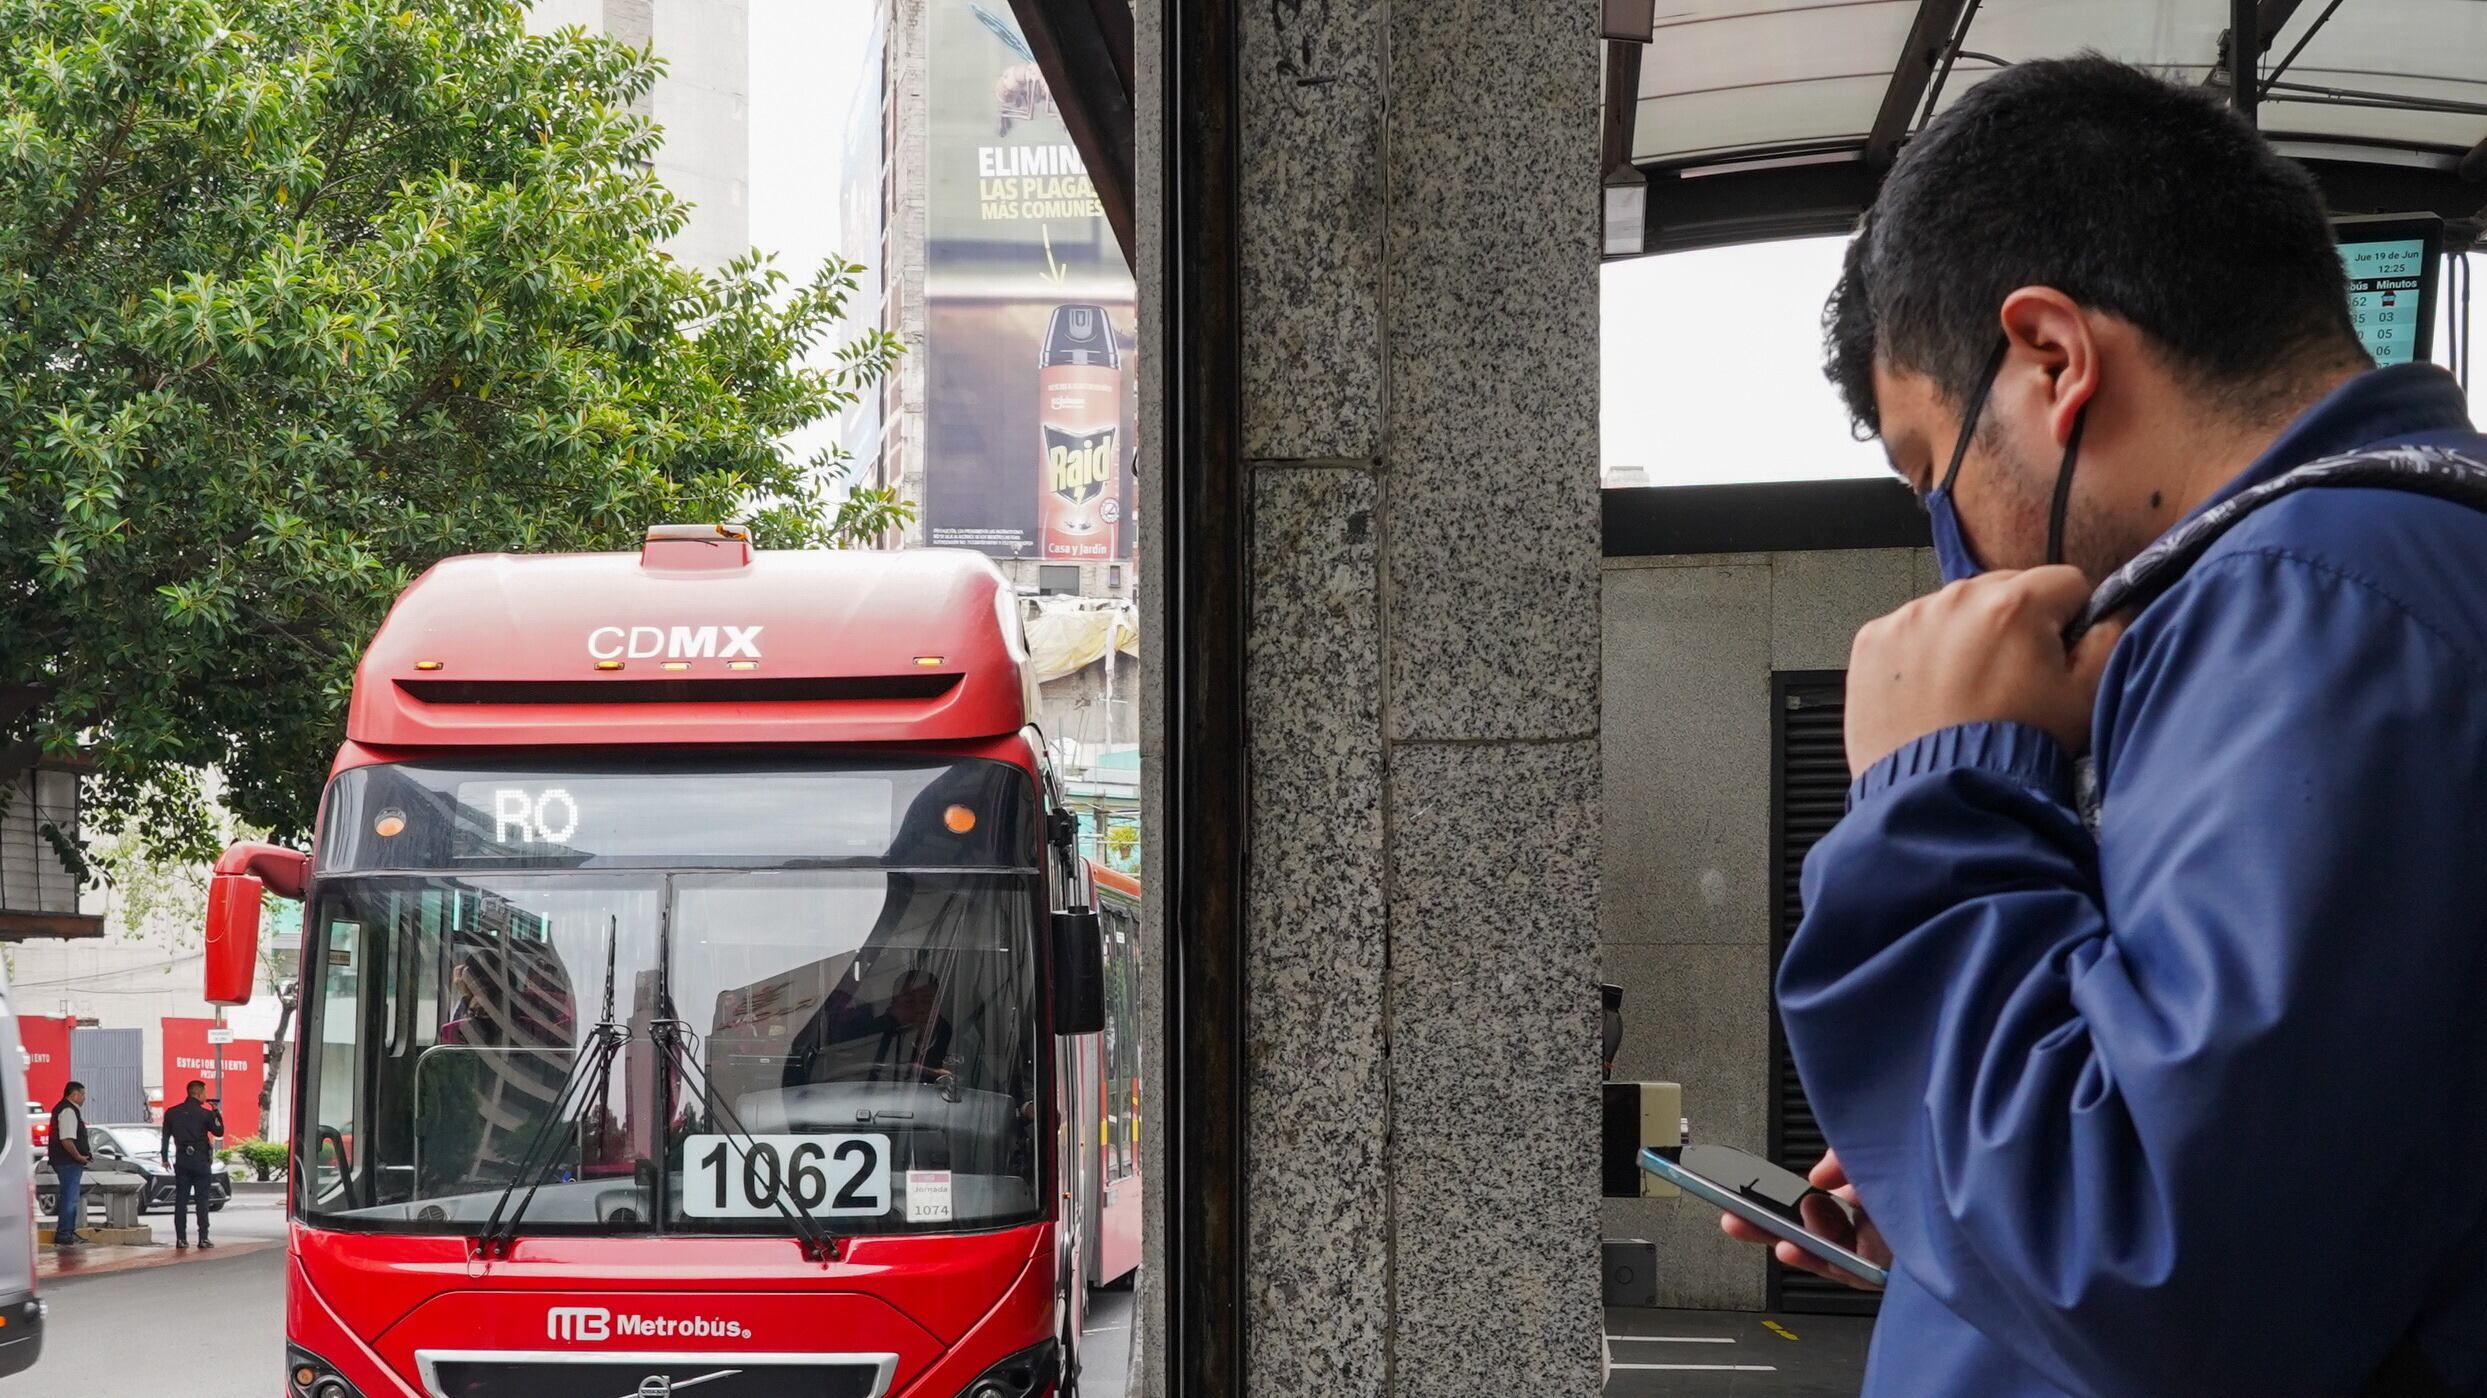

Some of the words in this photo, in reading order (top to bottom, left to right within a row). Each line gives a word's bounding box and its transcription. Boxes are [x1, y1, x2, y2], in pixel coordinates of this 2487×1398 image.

[980, 178, 1018, 200] LAS
[981, 200, 1018, 220] MÁS
[1022, 199, 1104, 218] COMUNES
[2355, 253, 2372, 261] Jue
[2375, 252, 2386, 260] 19
[2388, 251, 2400, 260] de
[2401, 250, 2419, 259] Jun
[2379, 264, 2405, 273] 12:25
[2347, 281, 2369, 291] bús
[2376, 279, 2418, 290] Minutos
[2378, 311, 2394, 323] 03
[2377, 329, 2393, 340] 05
[2375, 346, 2391, 356] 06
[1049, 435, 1110, 493] Raid
[1048, 543, 1070, 554] Casa
[1071, 544, 1079, 556] y
[1079, 543, 1107, 555] Jardín
[587, 626, 764, 659] CDMX
[701, 1140, 878, 1209] 1062
[914, 1205, 949, 1215] 1074
